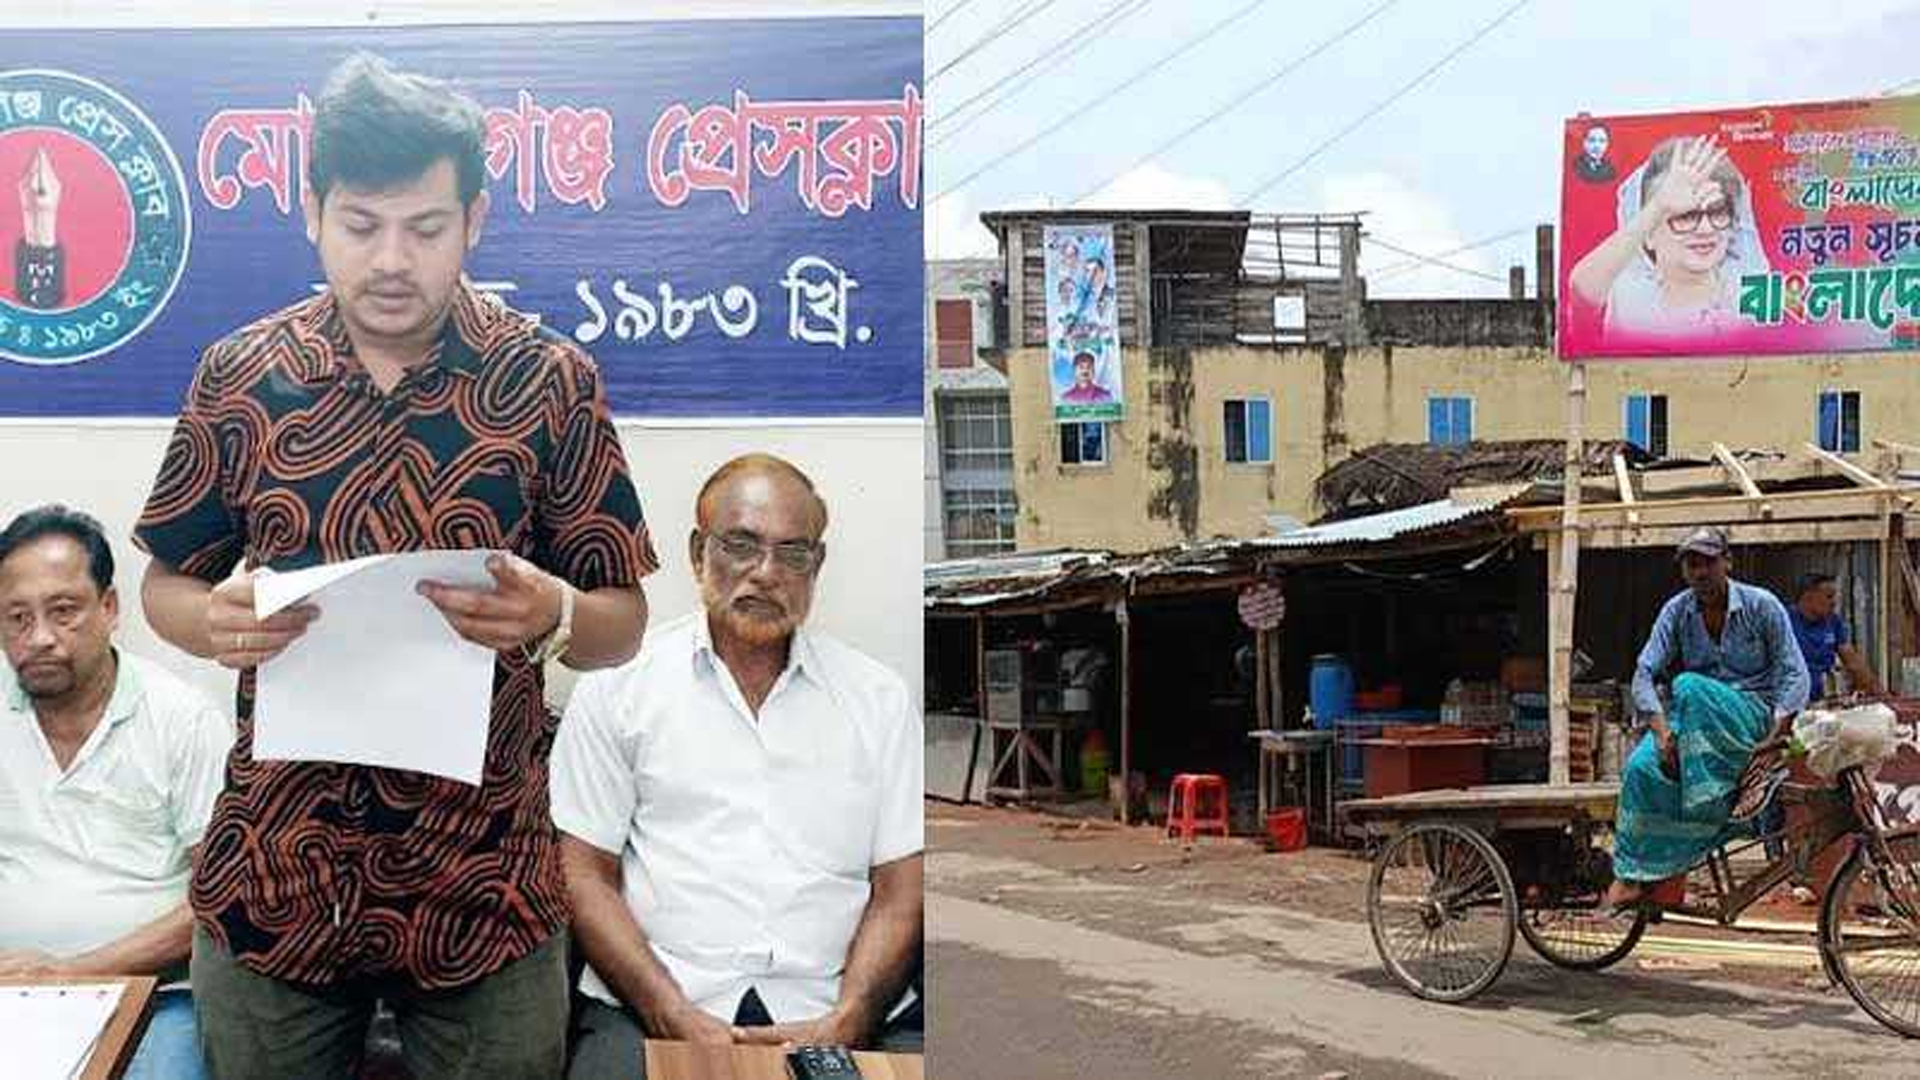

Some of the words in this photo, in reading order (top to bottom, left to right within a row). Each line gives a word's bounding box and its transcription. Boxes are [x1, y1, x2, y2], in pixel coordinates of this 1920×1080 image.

[647, 83, 923, 217] প্রেসক্লা
[1781, 226, 1851, 264] নতুন
[1866, 221, 1920, 262] সূচ
[44, 311, 118, 348] ১৯৮৩
[574, 280, 758, 342] ১৯৮৩
[1739, 267, 1920, 330] বাংলাদে
